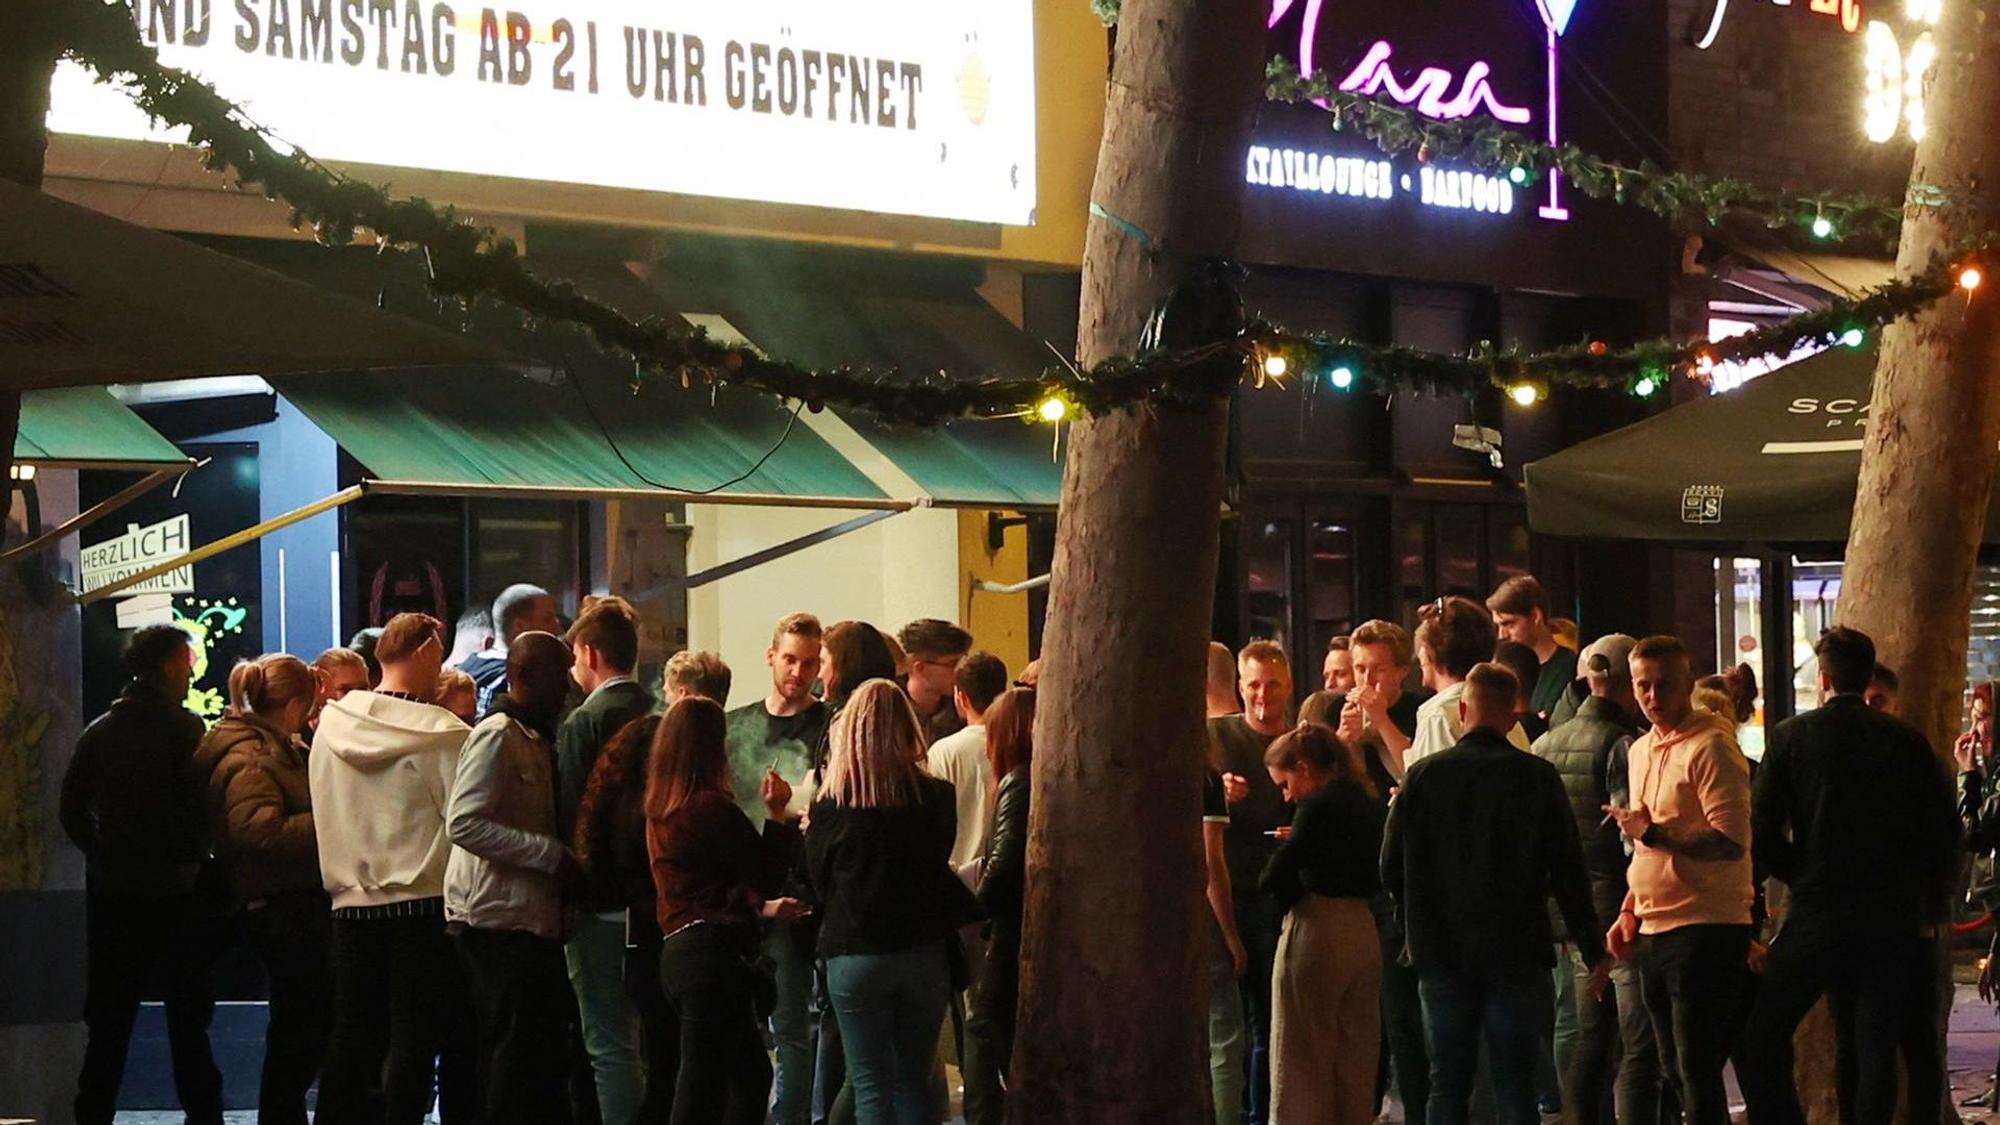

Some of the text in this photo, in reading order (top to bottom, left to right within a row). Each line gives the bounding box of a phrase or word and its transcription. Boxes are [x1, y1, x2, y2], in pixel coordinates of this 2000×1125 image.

[234, 0, 455, 77] SAMSTAG
[477, 7, 532, 86] AB
[552, 17, 599, 95] 21
[623, 25, 707, 107] UHR
[724, 26, 922, 130] GEÖFFNET
[1420, 166, 1513, 215] BARFOOD
[82, 520, 184, 570] HERZLICH
